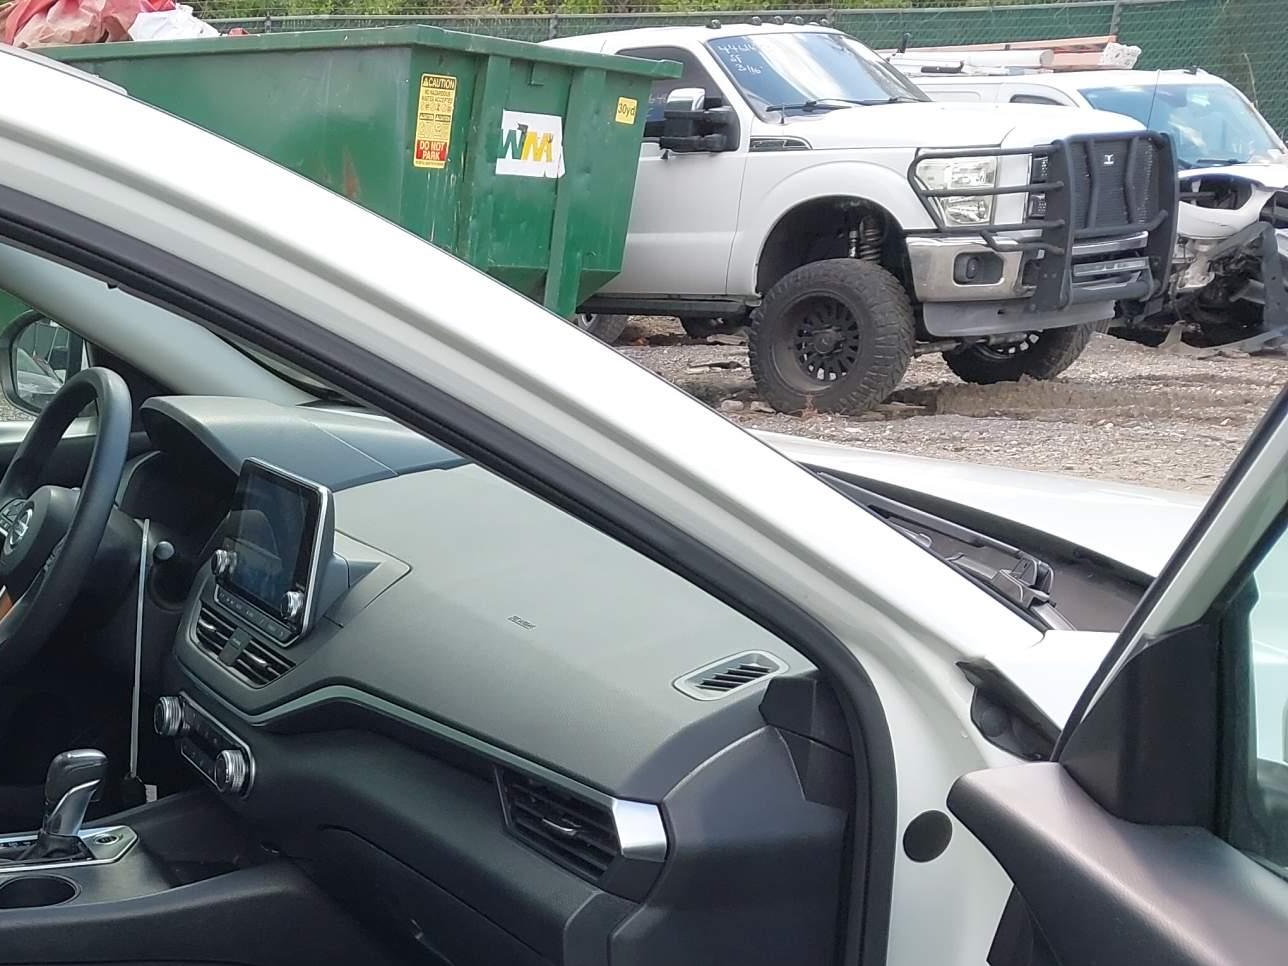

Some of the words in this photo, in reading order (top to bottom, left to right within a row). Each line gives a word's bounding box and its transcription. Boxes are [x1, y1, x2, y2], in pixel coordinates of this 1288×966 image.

[429, 76, 455, 89] CAUTION
[618, 103, 635, 118] 30yd
[419, 140, 430, 150] DO
[431, 141, 446, 151] NOT
[422, 150, 441, 161] PARK
